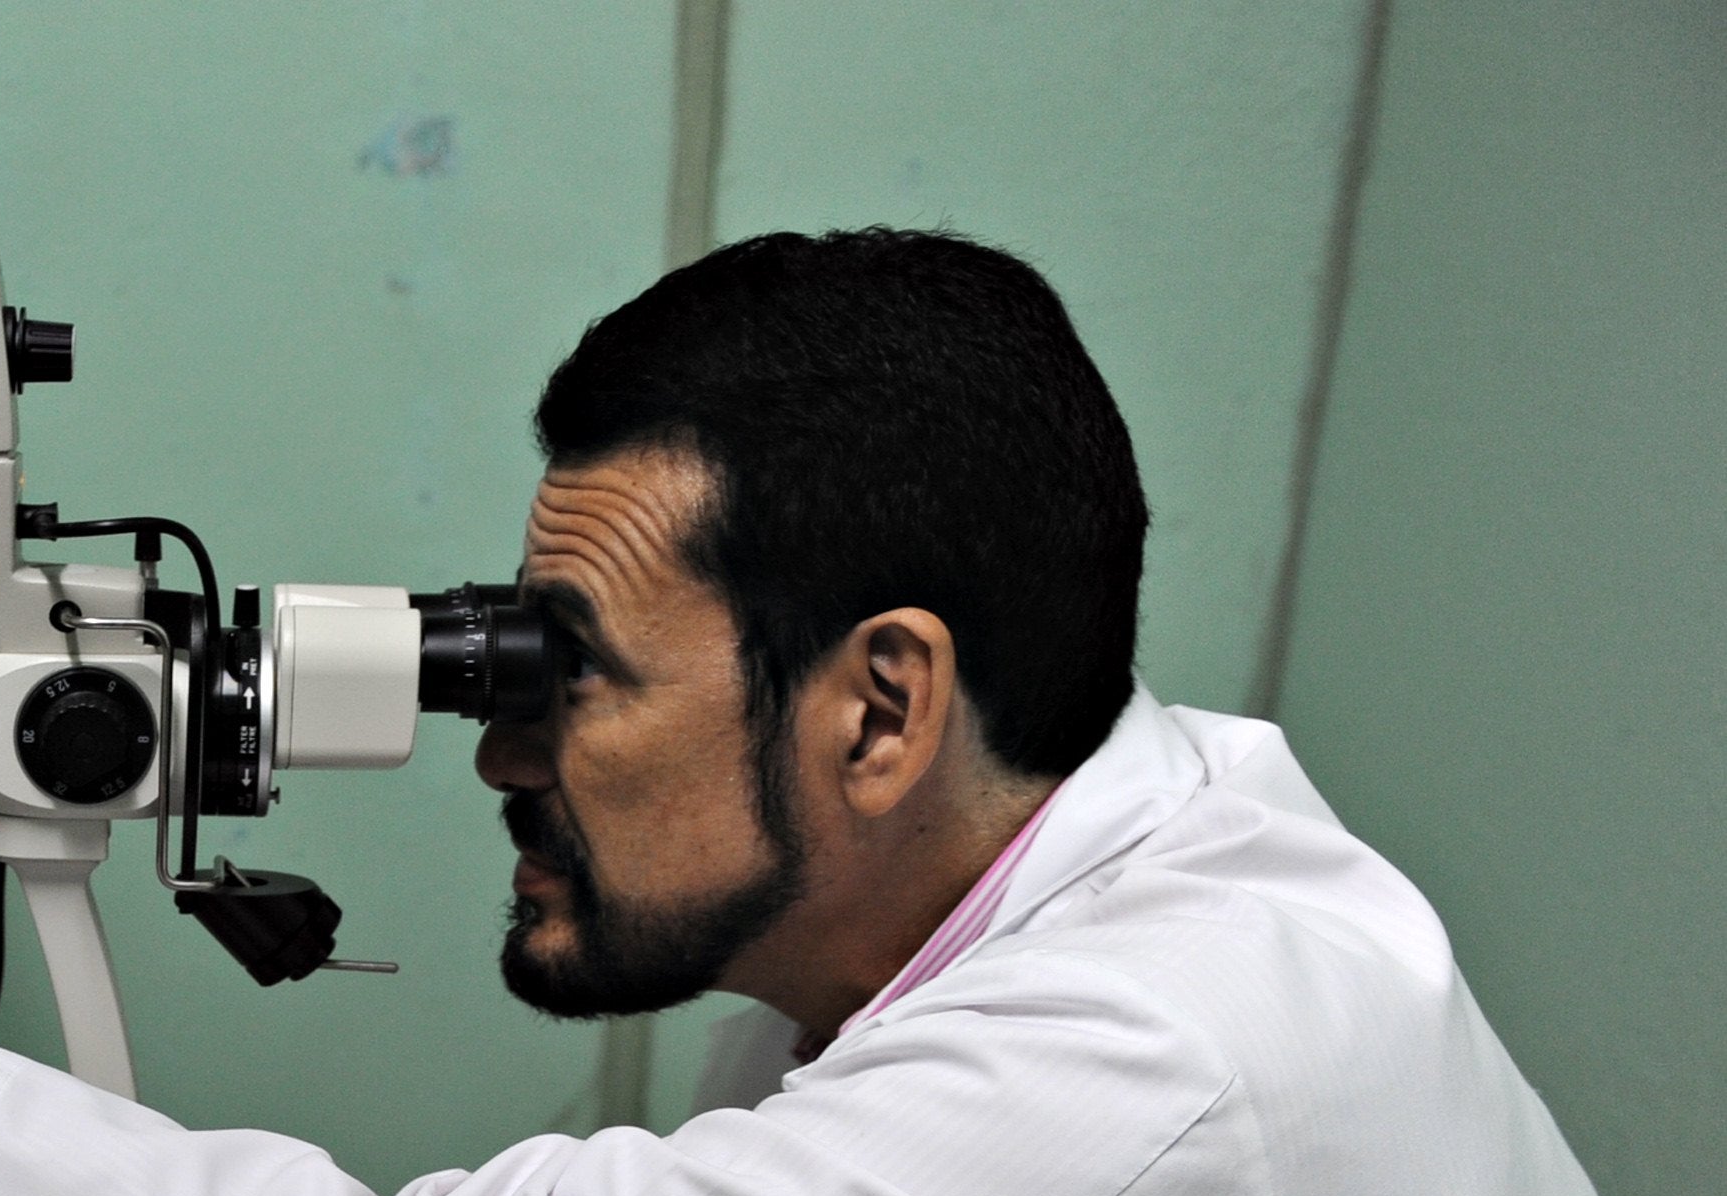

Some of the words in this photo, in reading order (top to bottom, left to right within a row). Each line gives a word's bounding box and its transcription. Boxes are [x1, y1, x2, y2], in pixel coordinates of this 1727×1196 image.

[106, 680, 117, 693] 5
[22, 729, 35, 743] 20
[137, 735, 150, 743] 8
[239, 725, 248, 755] FILTER
[248, 725, 257, 755] FILTRE
